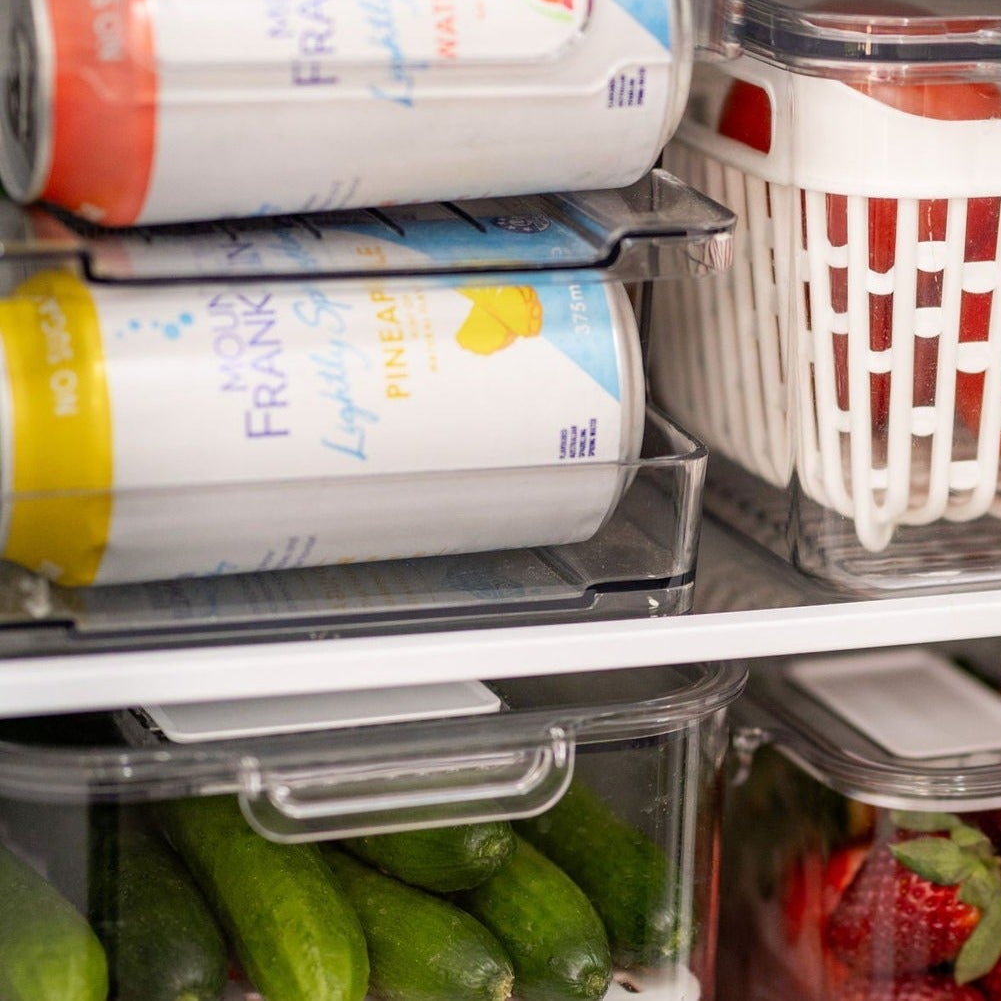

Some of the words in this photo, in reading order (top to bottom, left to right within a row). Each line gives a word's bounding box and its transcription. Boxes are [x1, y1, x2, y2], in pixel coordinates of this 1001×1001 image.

[93, 13, 123, 60] NO
[568, 284, 591, 336] 375m
[49, 370, 78, 416] NO
[308, 339, 379, 461] Lightly
